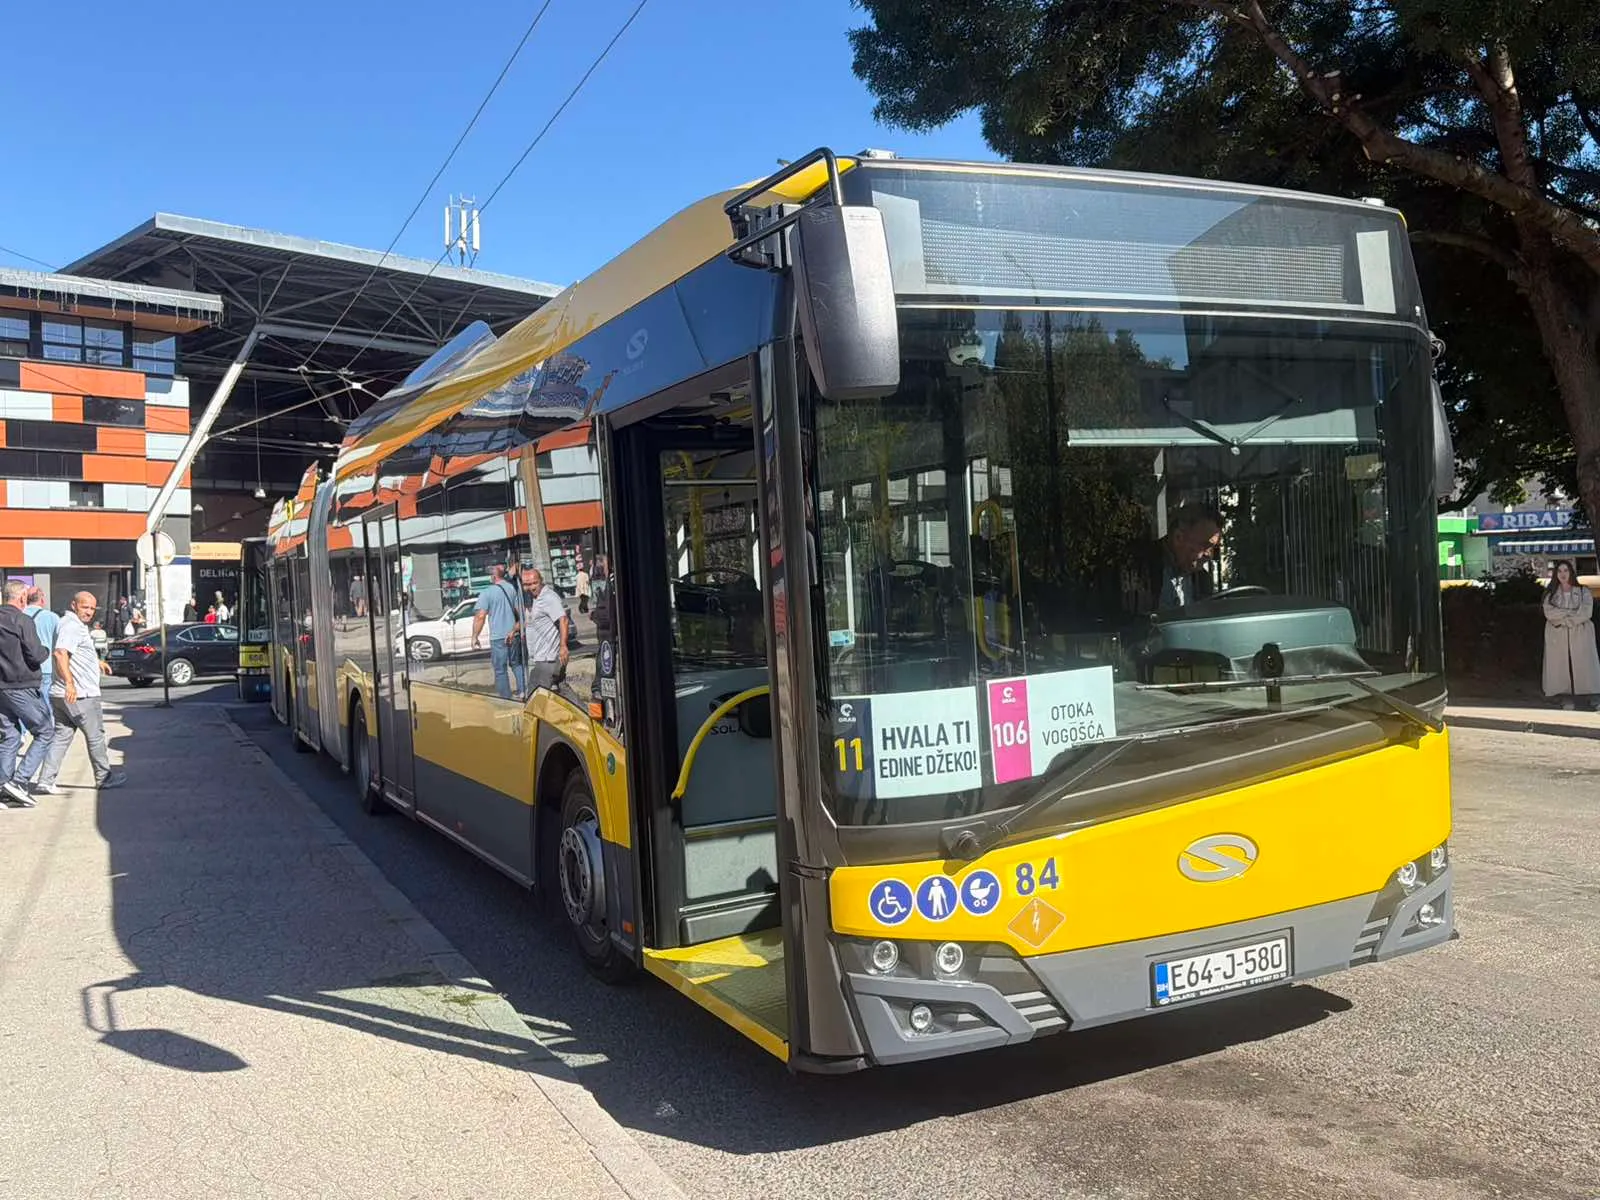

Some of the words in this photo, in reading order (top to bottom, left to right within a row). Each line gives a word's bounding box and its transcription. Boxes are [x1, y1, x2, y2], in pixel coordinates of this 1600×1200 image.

[1051, 701, 1095, 721] OTOKA
[710, 724, 742, 736] SOL
[881, 722, 949, 751] HVALA
[952, 720, 971, 745] TI
[993, 720, 1029, 748] 106
[1042, 720, 1105, 746] VOGOŠĆA
[834, 737, 863, 771] 11
[879, 756, 924, 779] EDINE
[926, 748, 978, 776] DŽEKO!
[1015, 856, 1060, 896] 84
[1171, 943, 1283, 992] E64-J-580
